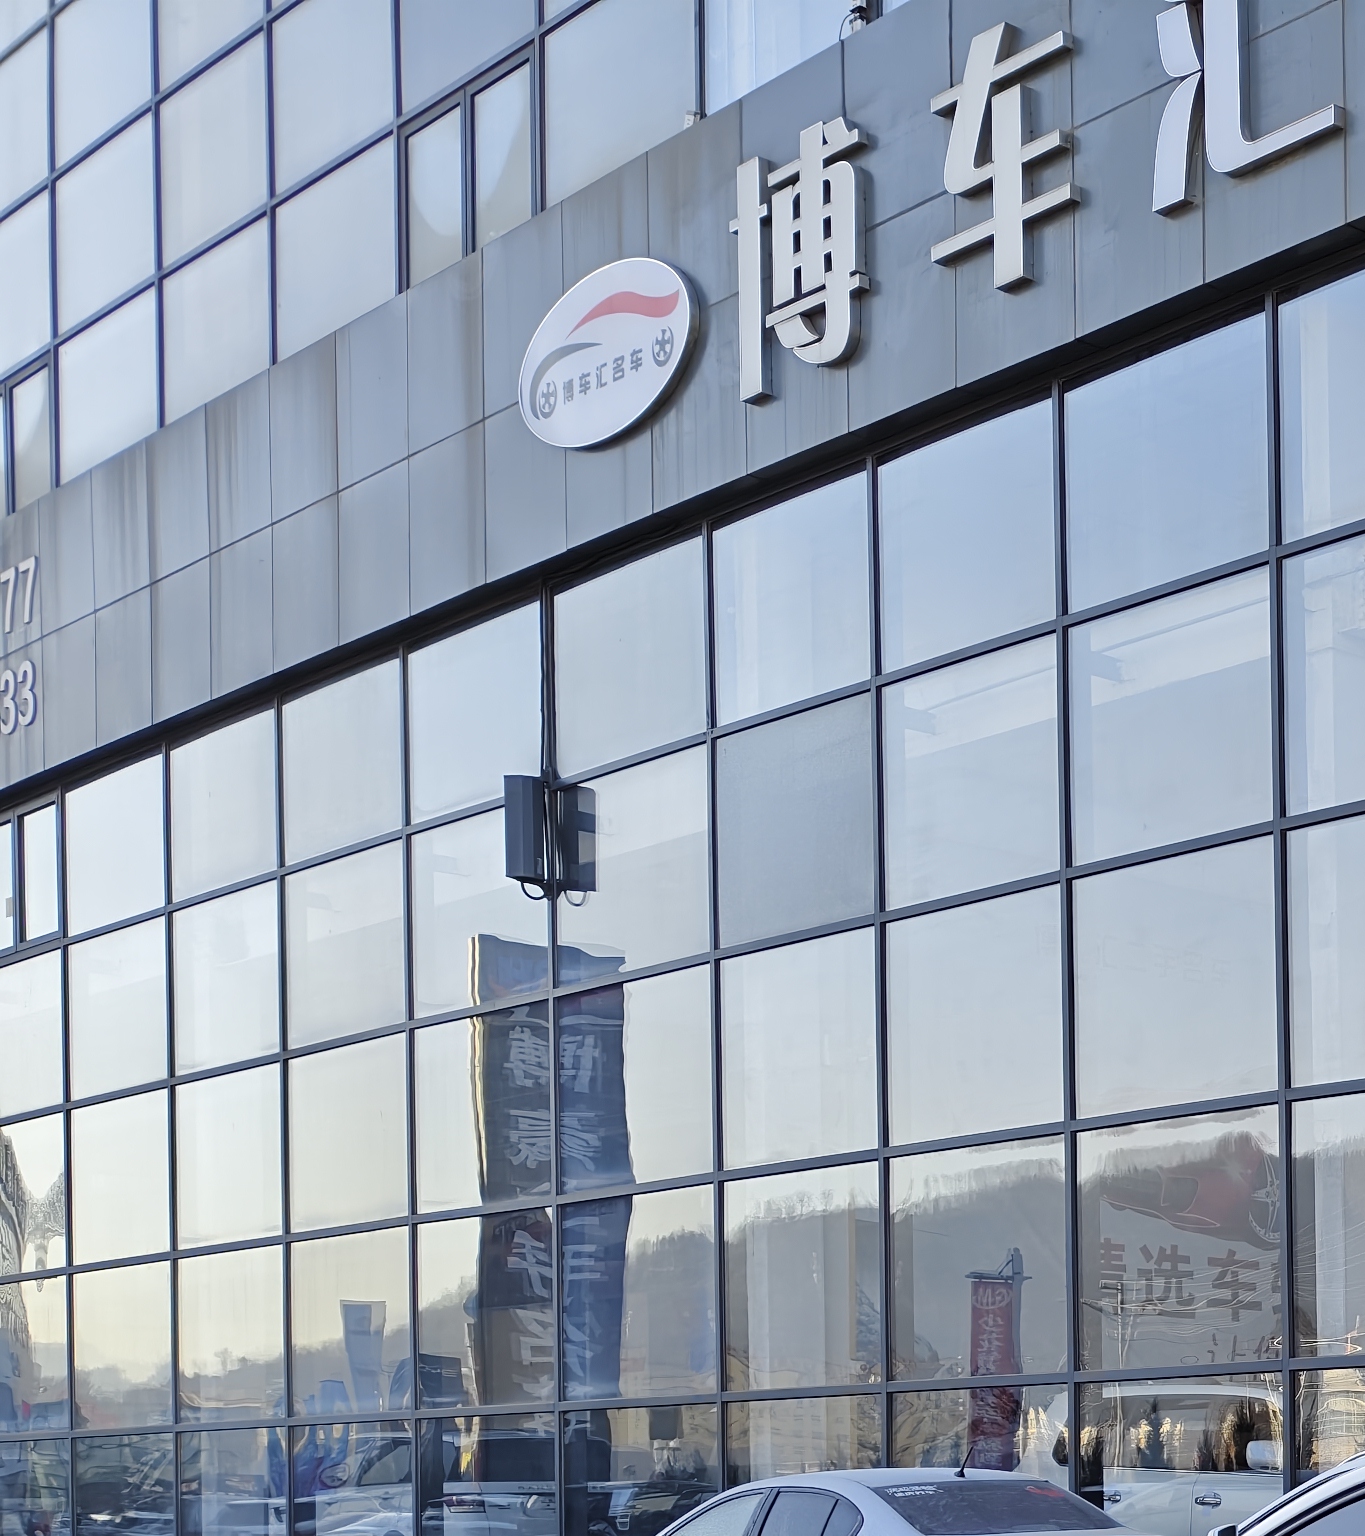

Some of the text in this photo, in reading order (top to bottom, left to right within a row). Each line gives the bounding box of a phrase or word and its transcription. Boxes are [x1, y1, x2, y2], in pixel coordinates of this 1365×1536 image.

[562, 347, 644, 406] 博车汇名车
